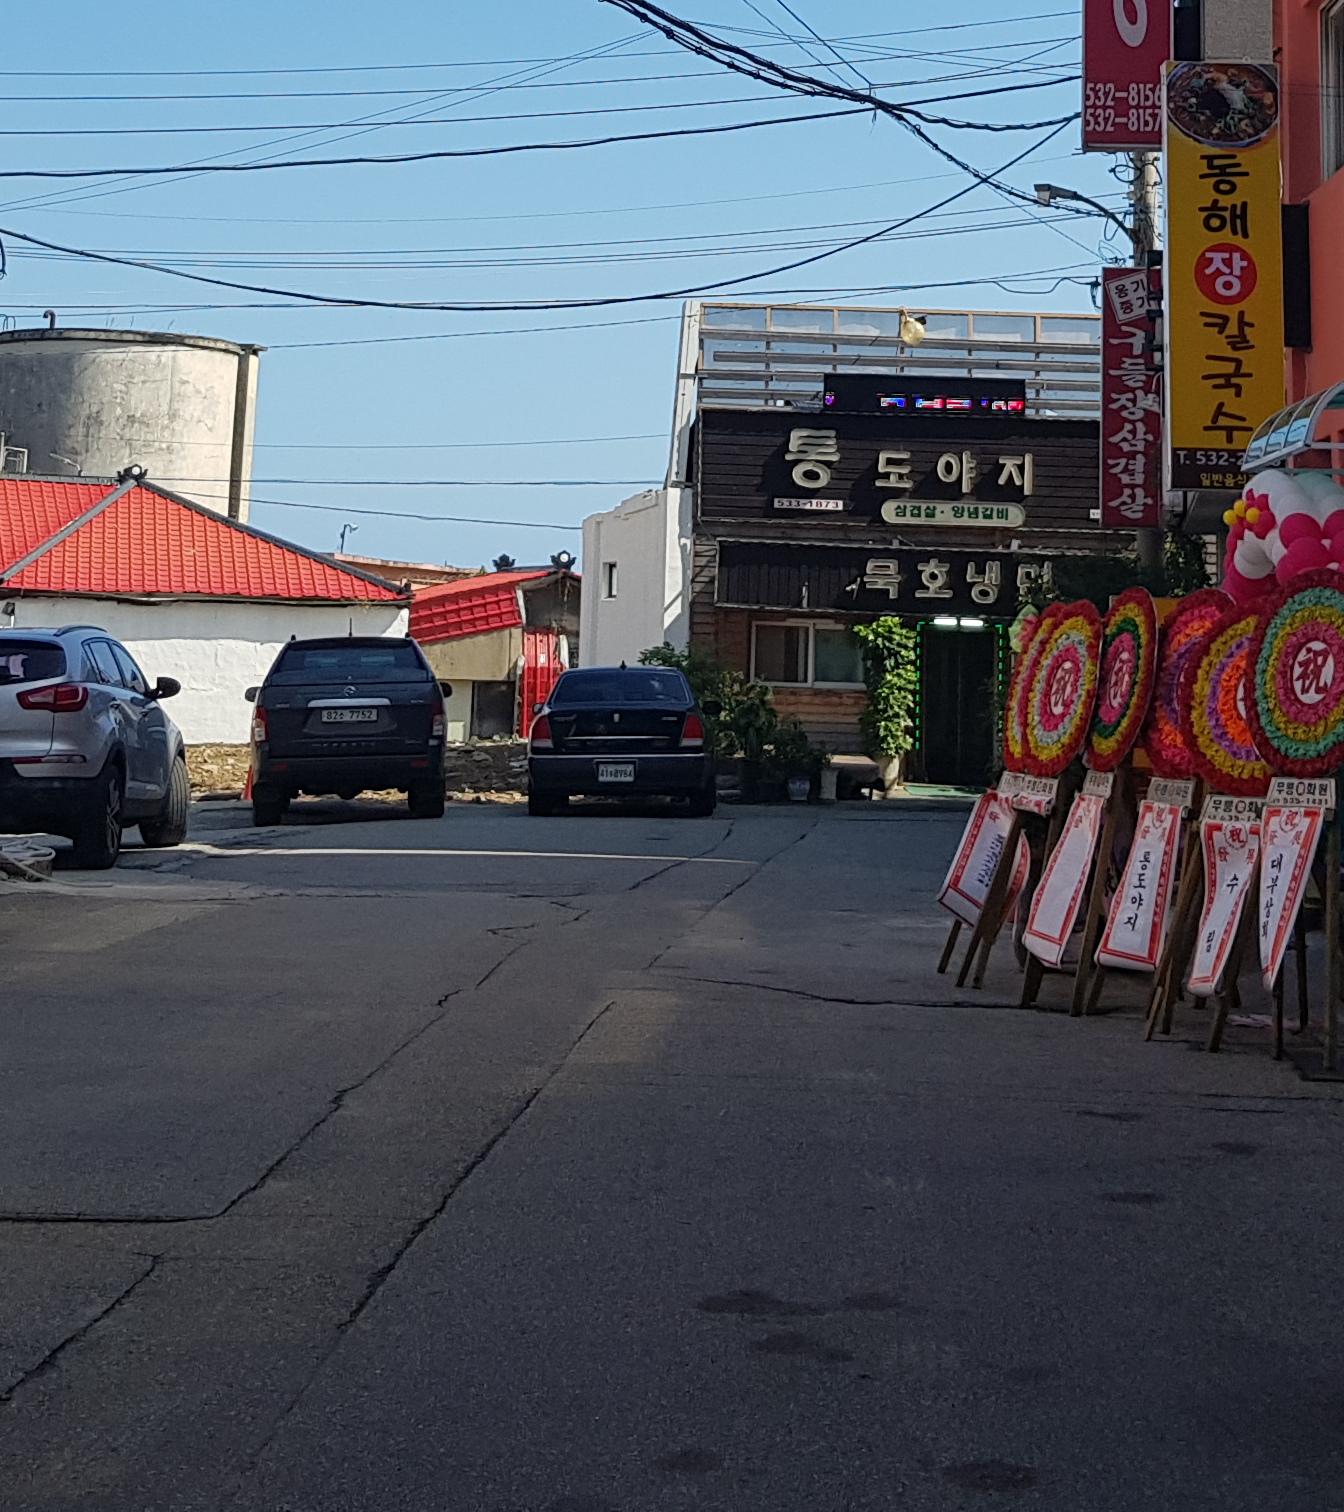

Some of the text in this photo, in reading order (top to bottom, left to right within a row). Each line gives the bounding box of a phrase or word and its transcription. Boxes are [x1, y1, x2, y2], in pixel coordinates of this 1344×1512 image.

[1085, 108, 1162, 132] 532-8157
[1197, 153, 1256, 444] 동해장칼국수
[784, 427, 1034, 496] 통도야지
[1199, 471, 1255, 487] 일반음식
[776, 499, 841, 510] 533-1873
[348, 709, 373, 720] 7752
[1123, 850, 1152, 932] 통도야지
